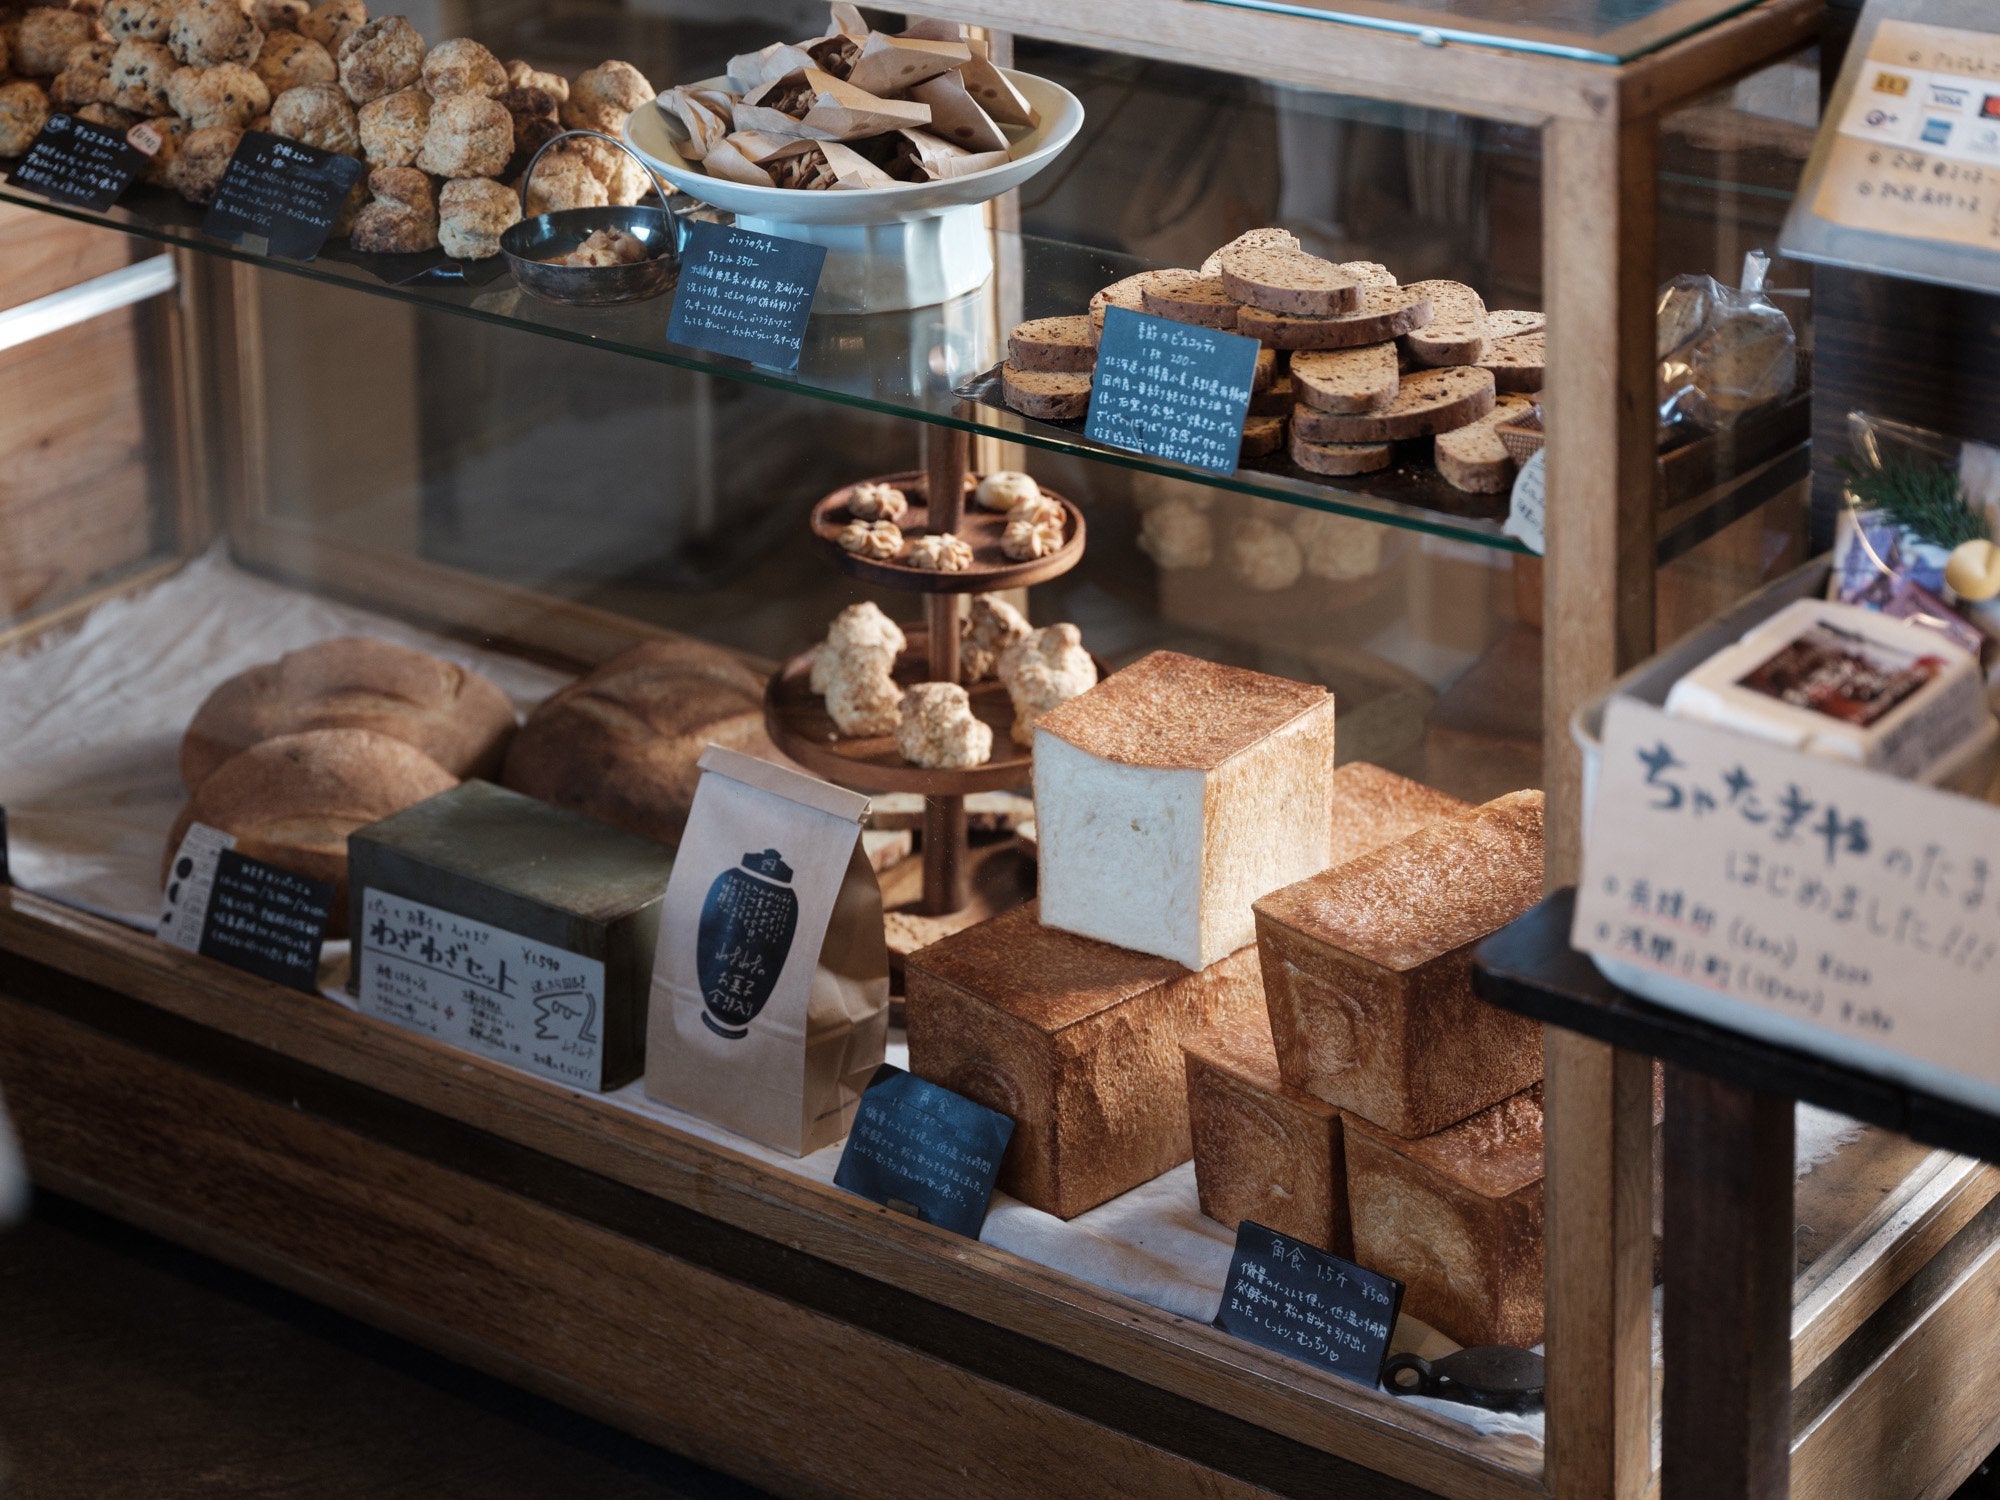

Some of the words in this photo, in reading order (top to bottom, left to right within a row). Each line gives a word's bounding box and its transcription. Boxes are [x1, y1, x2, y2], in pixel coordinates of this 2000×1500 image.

[369, 917, 519, 993] わざわざセット
[1270, 1238, 1307, 1272] 角食
[1316, 1263, 1349, 1288] 1.5斤
[1361, 1280, 1390, 1306] ¥500
